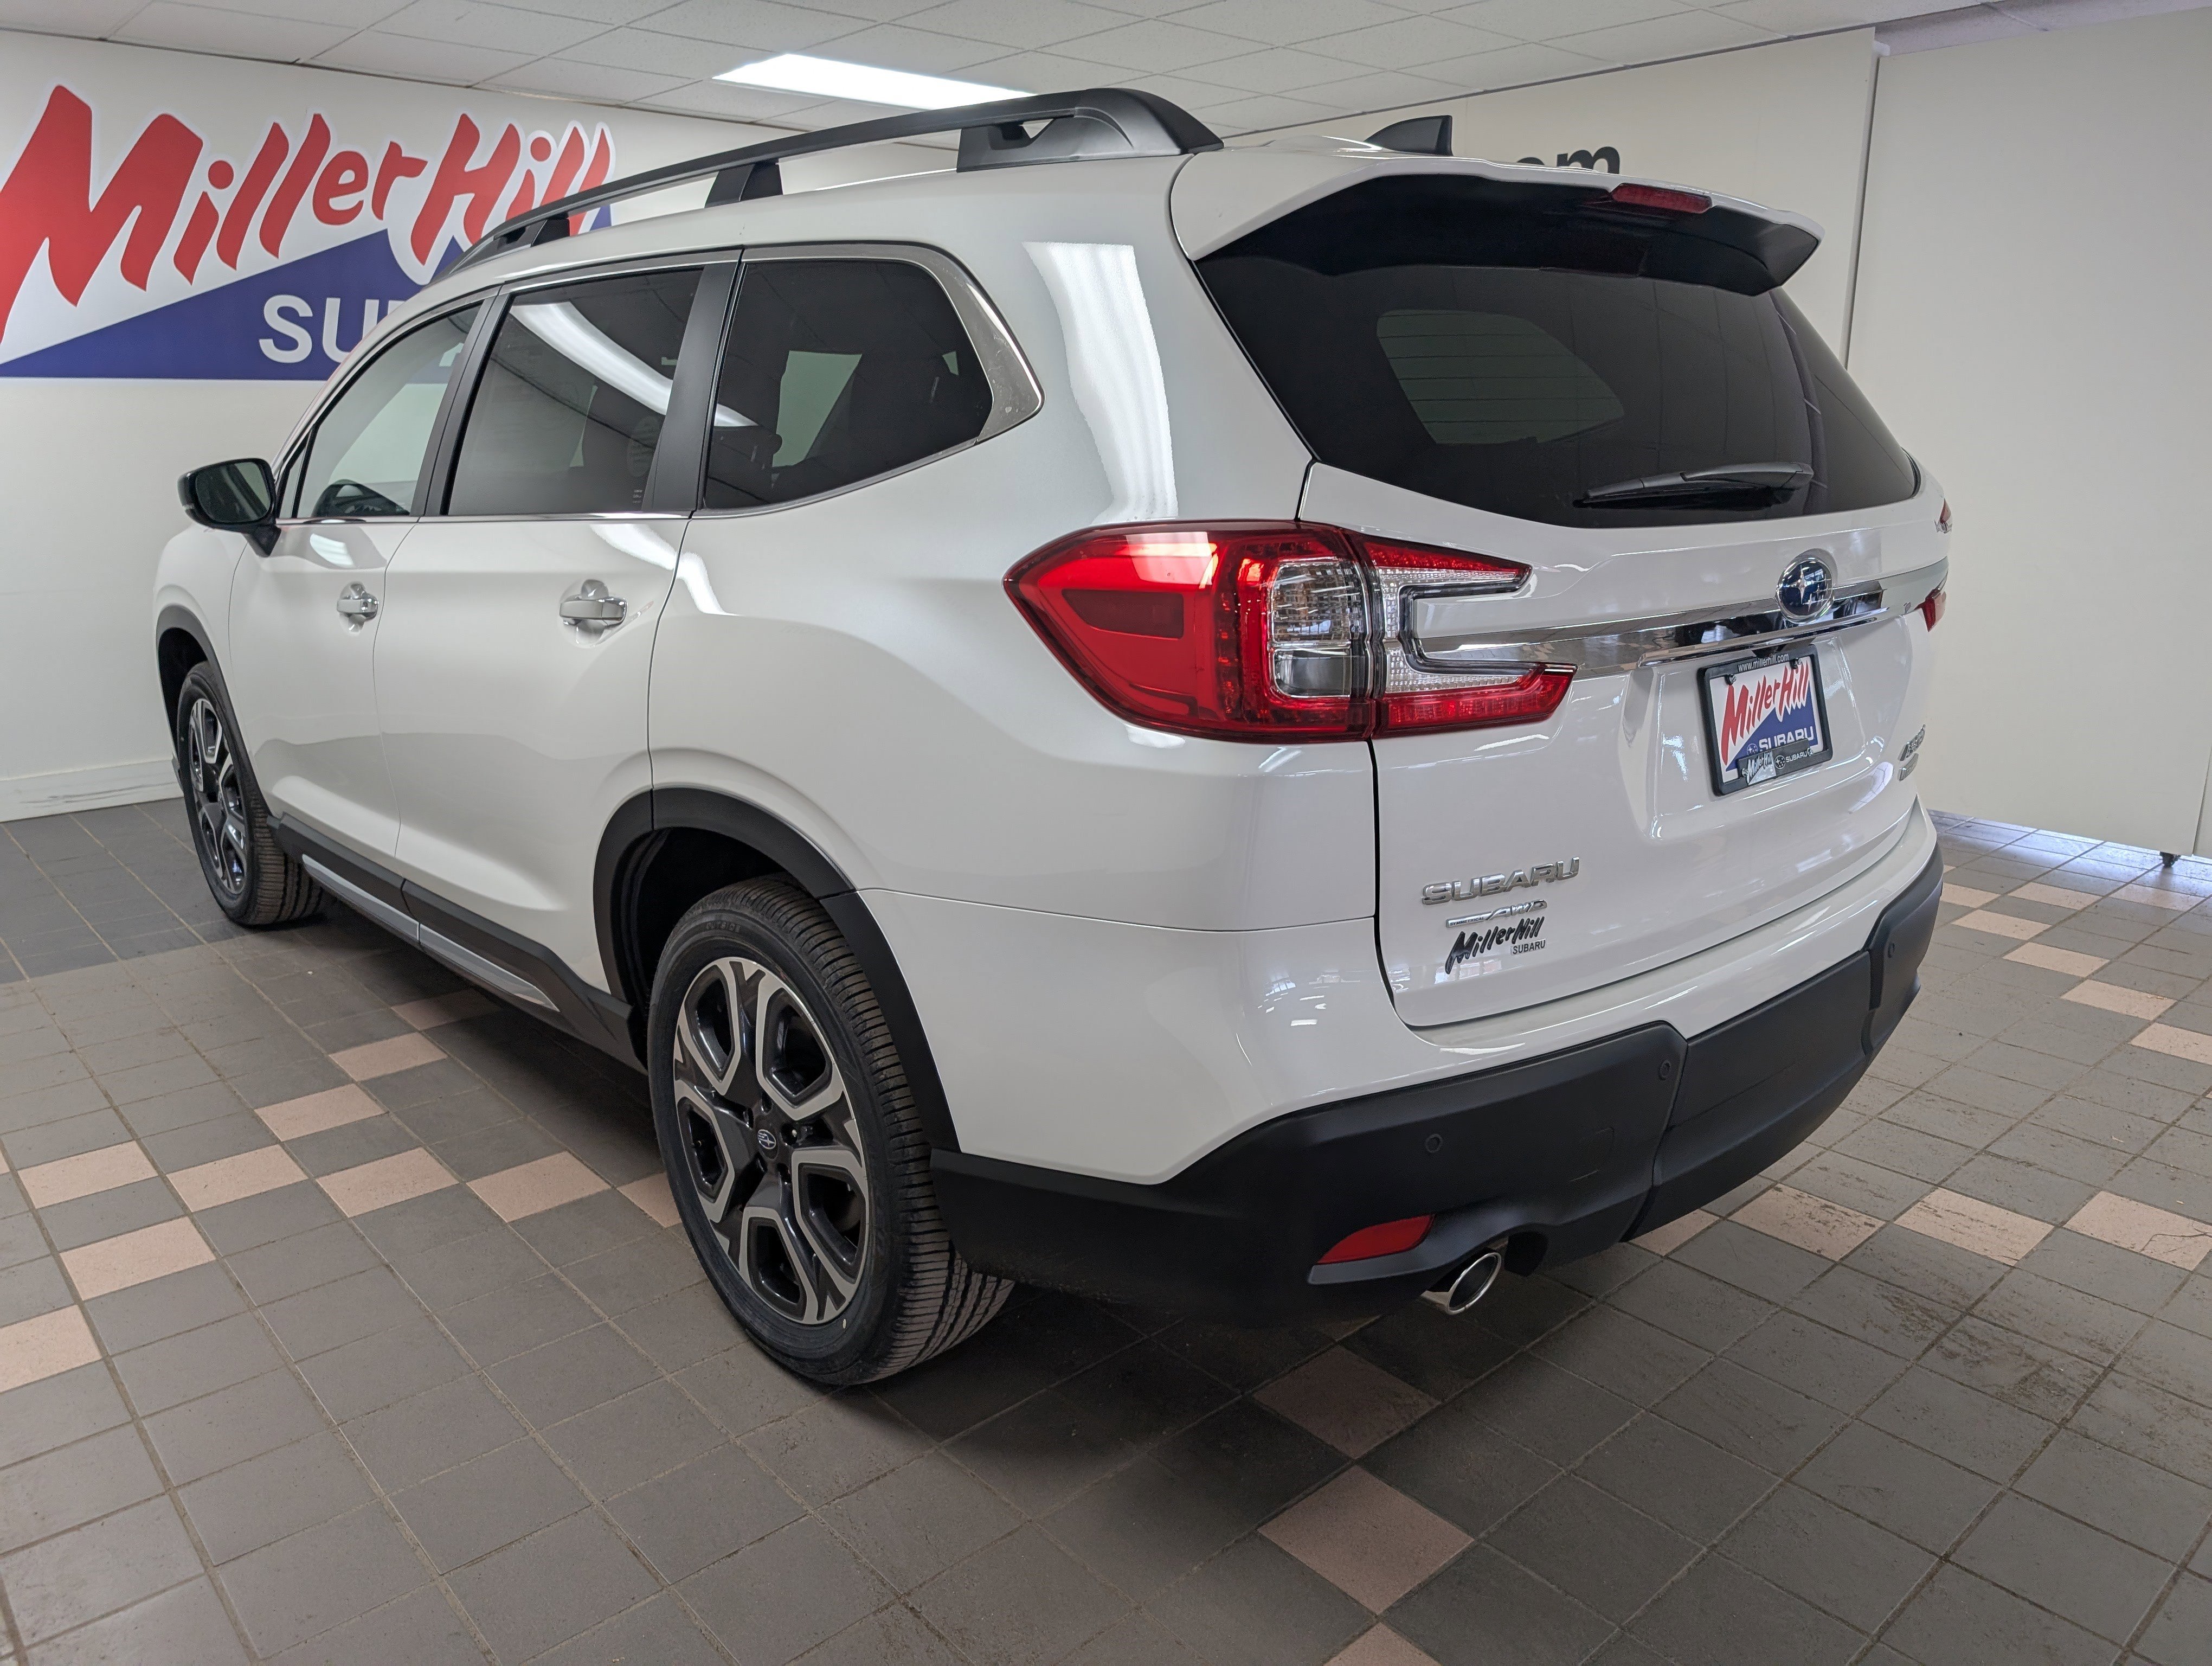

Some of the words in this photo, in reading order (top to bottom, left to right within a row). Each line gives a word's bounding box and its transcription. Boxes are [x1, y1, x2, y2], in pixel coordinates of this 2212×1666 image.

[259, 294, 407, 363] SU
[1738, 653, 1789, 672] www.millerhill.com
[1785, 751, 1808, 763] SUBARU
[1422, 857, 1580, 905] SUBARU
[1449, 917, 1485, 926] SYMMETRICAL
[1486, 899, 1548, 920] AWD
[1512, 939, 1546, 954] SUBARU
